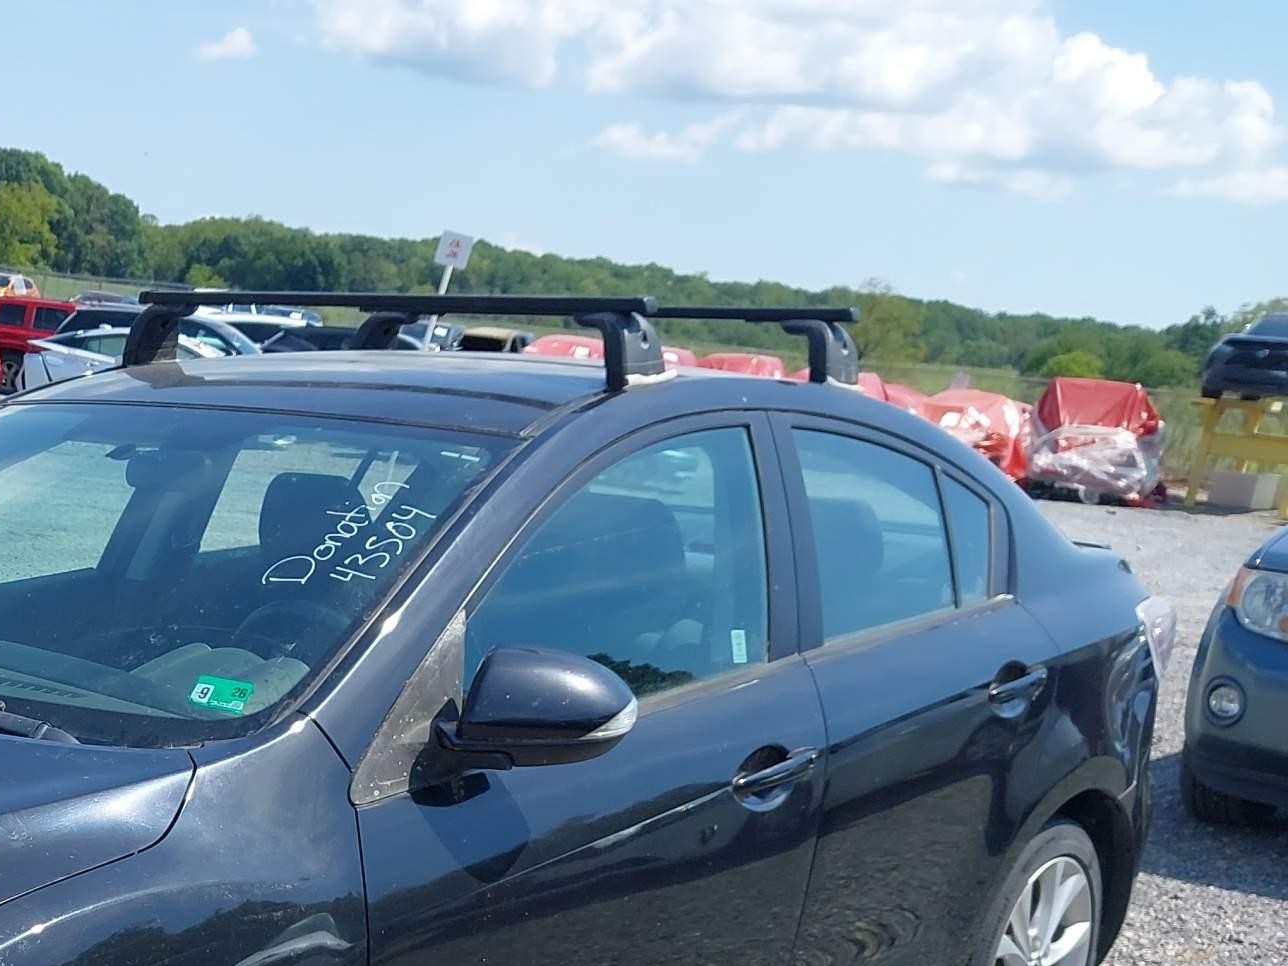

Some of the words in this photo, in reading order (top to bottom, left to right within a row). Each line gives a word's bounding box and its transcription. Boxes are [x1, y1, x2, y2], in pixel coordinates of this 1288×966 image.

[262, 481, 410, 584] Donation
[329, 505, 437, 583] 43504
[198, 686, 211, 700] 9
[231, 686, 249, 699] 26
